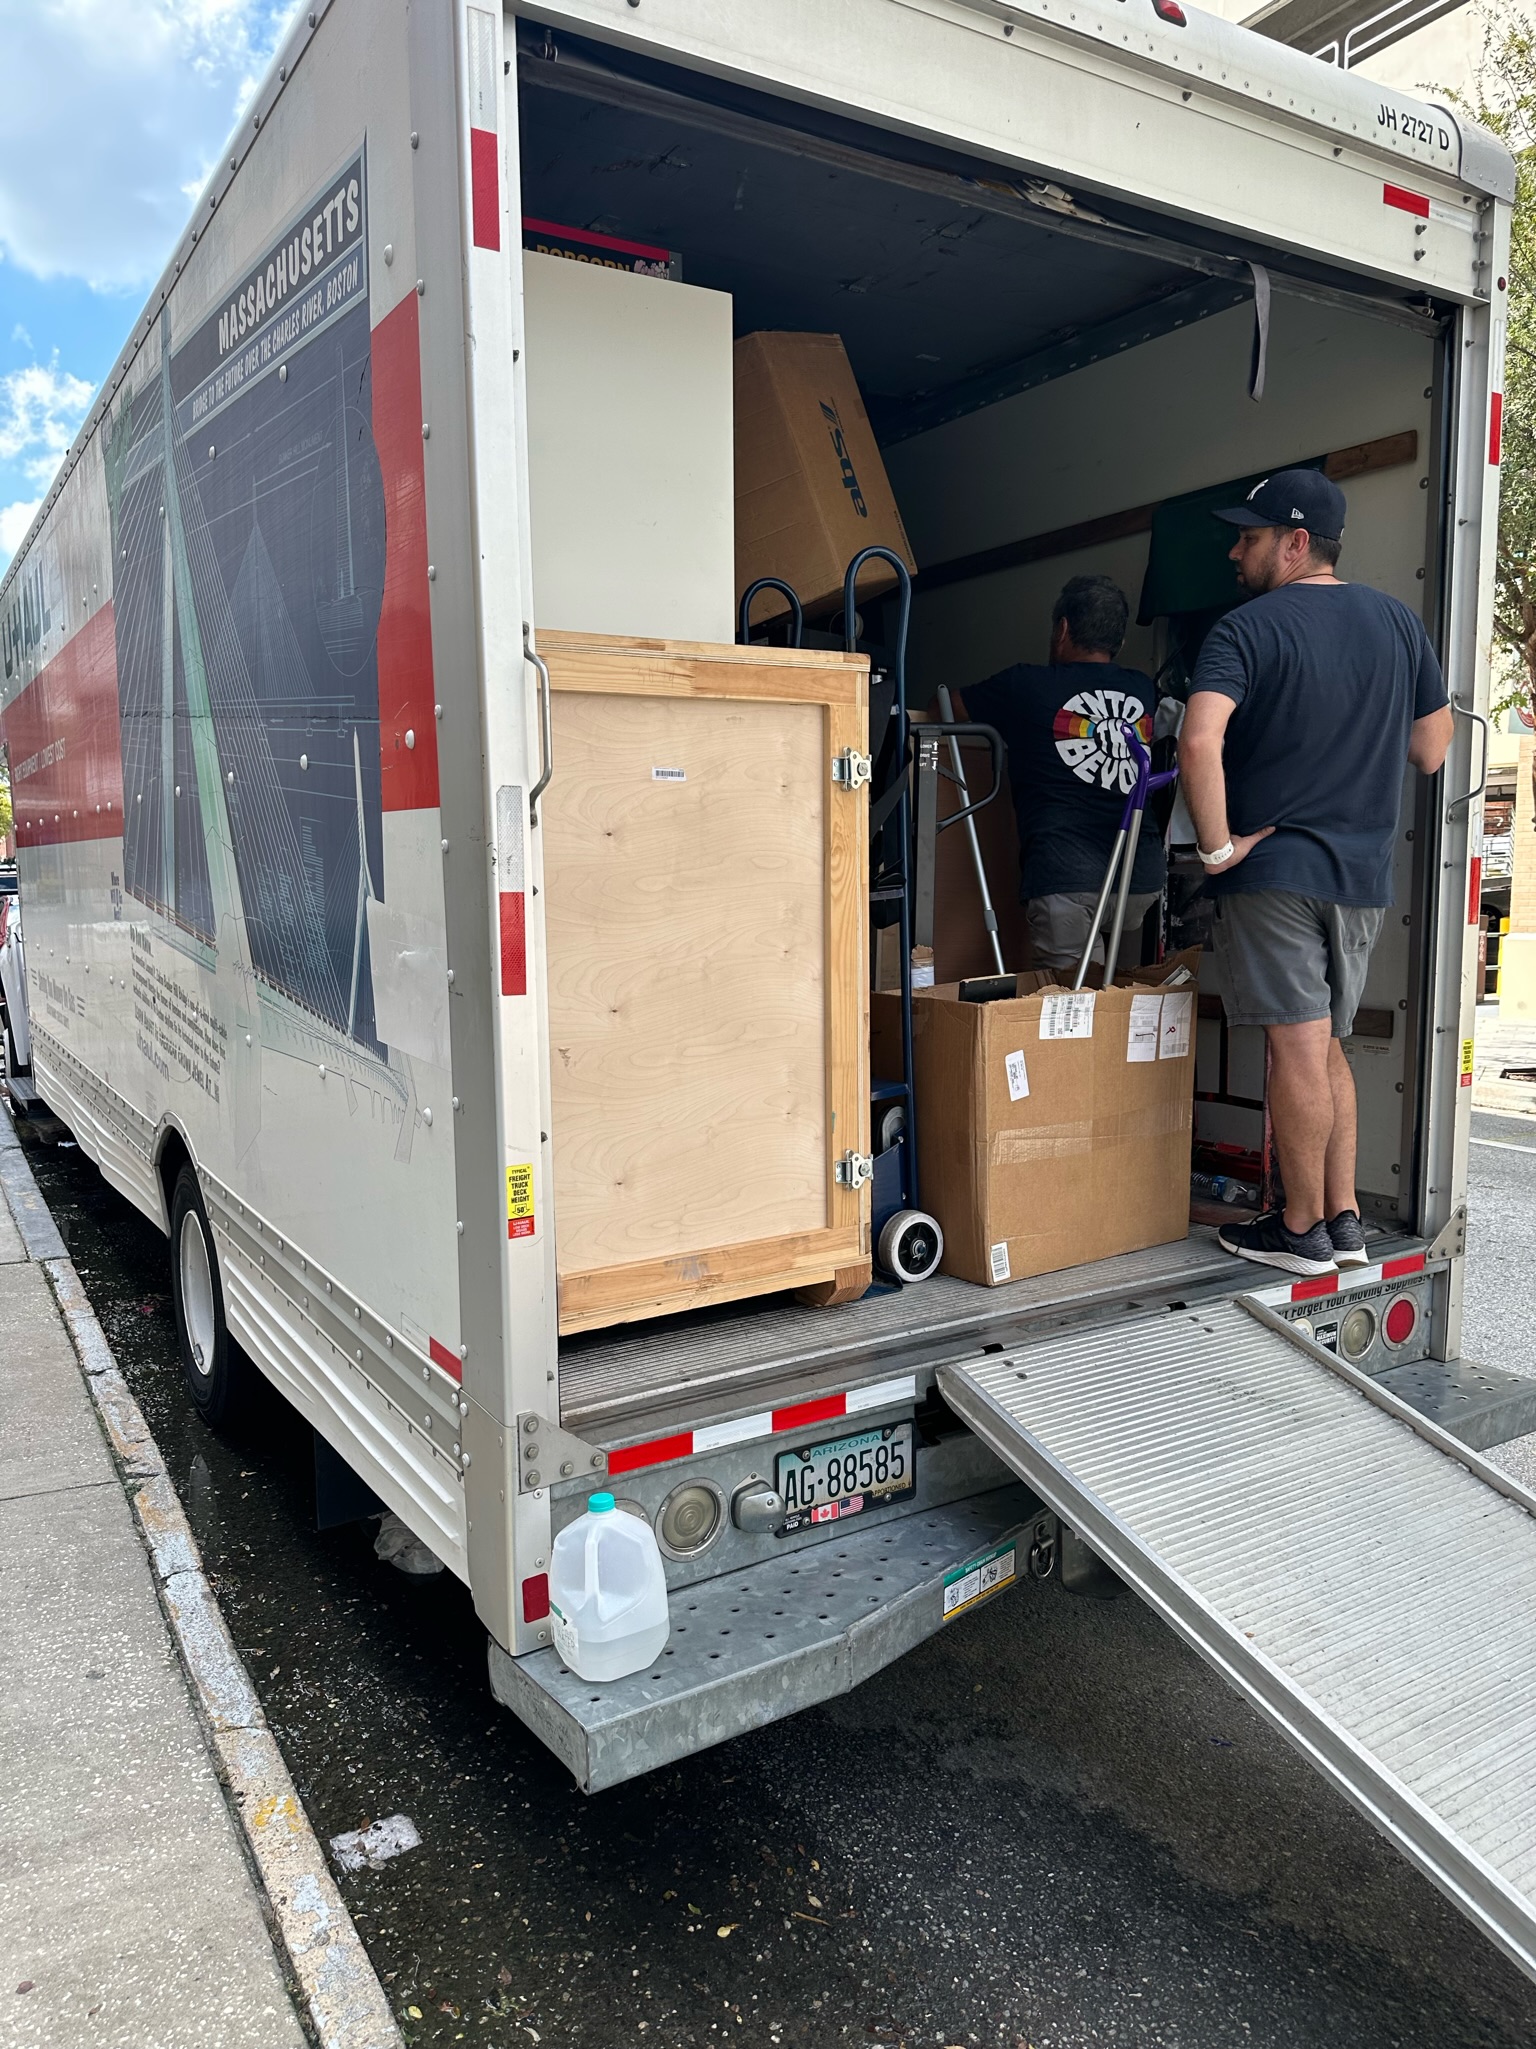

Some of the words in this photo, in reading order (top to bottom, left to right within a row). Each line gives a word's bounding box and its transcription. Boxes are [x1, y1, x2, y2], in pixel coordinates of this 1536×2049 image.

[1378, 104, 1397, 130] JH
[1402, 113, 1433, 145] 2727
[1438, 128, 1449, 150] D
[219, 178, 359, 355] MASSACHUSETTS
[225, 360, 243, 395] FUTURE
[245, 348, 260, 380] OVER
[260, 337, 271, 365] THE
[272, 315, 300, 353] CHARLES
[327, 257, 358, 310] BOSTON
[1063, 690, 1144, 724] INTO
[1096, 719, 1131, 759] TH
[1055, 738, 1151, 794] BEYO
[509, 1174, 530, 1182] FREIGHT
[511, 1182, 528, 1190] TRUCK
[511, 1195, 529, 1204] HEIGHT
[1291, 1300, 1323, 1317] Forget
[1327, 1295, 1347, 1309] Your
[812, 1434, 880, 1458] ARIZONA
[787, 1522, 798, 1530] PAID
